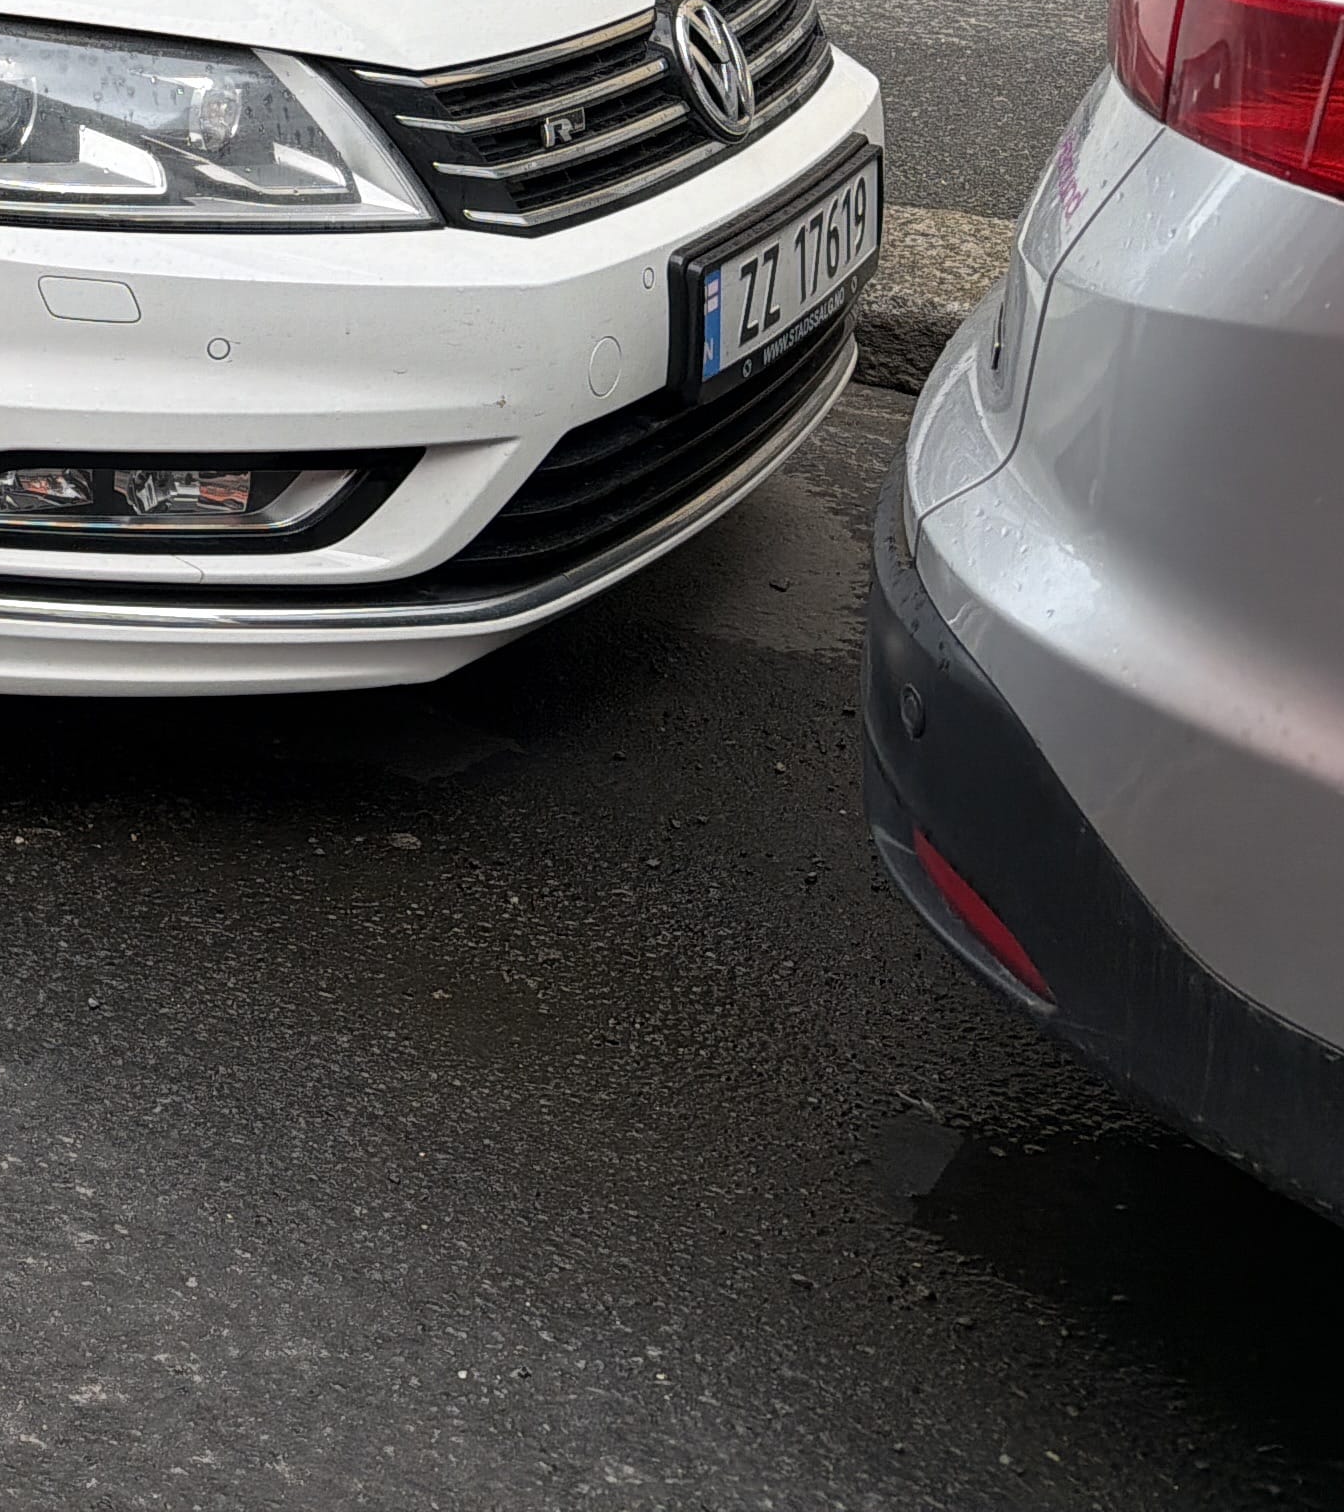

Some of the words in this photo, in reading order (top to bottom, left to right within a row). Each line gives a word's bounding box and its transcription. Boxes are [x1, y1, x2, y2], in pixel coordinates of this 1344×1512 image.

[738, 244, 781, 347] ZZ
[794, 176, 867, 305] 17619
[703, 338, 714, 362] N
[763, 286, 845, 366] WWW.STADSSALG.NO
